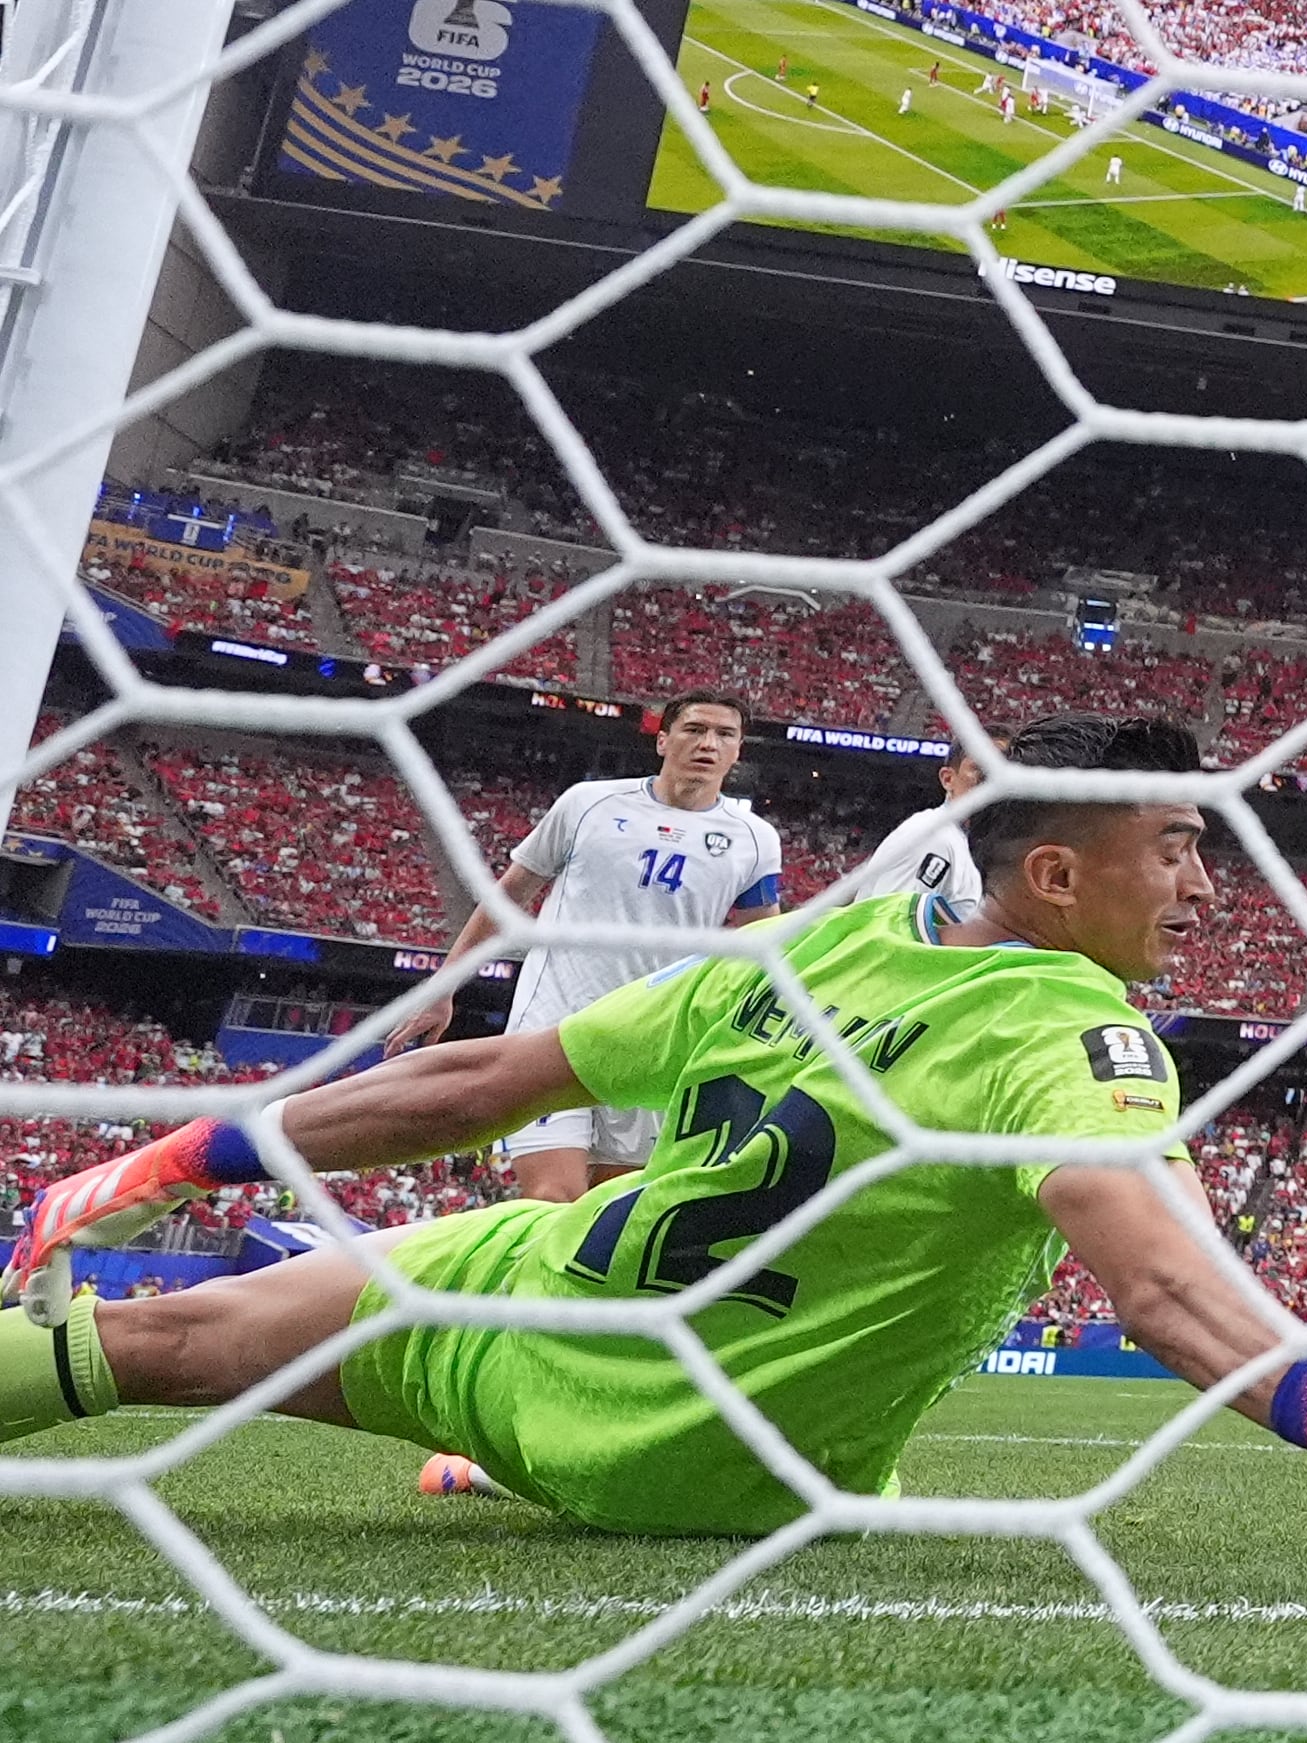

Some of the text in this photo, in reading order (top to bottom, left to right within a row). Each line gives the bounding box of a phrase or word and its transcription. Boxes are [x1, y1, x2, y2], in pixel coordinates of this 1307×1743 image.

[437, 29, 480, 48] FIFA
[403, 53, 501, 79] WORLD CUP
[397, 67, 498, 99] 2026
[786, 726, 950, 757] FIFA WORLD CUP 20
[706, 834, 729, 850] UFA
[638, 848, 687, 895] 14
[111, 898, 140, 910] FIFA
[85, 908, 161, 923] WORLD CUP
